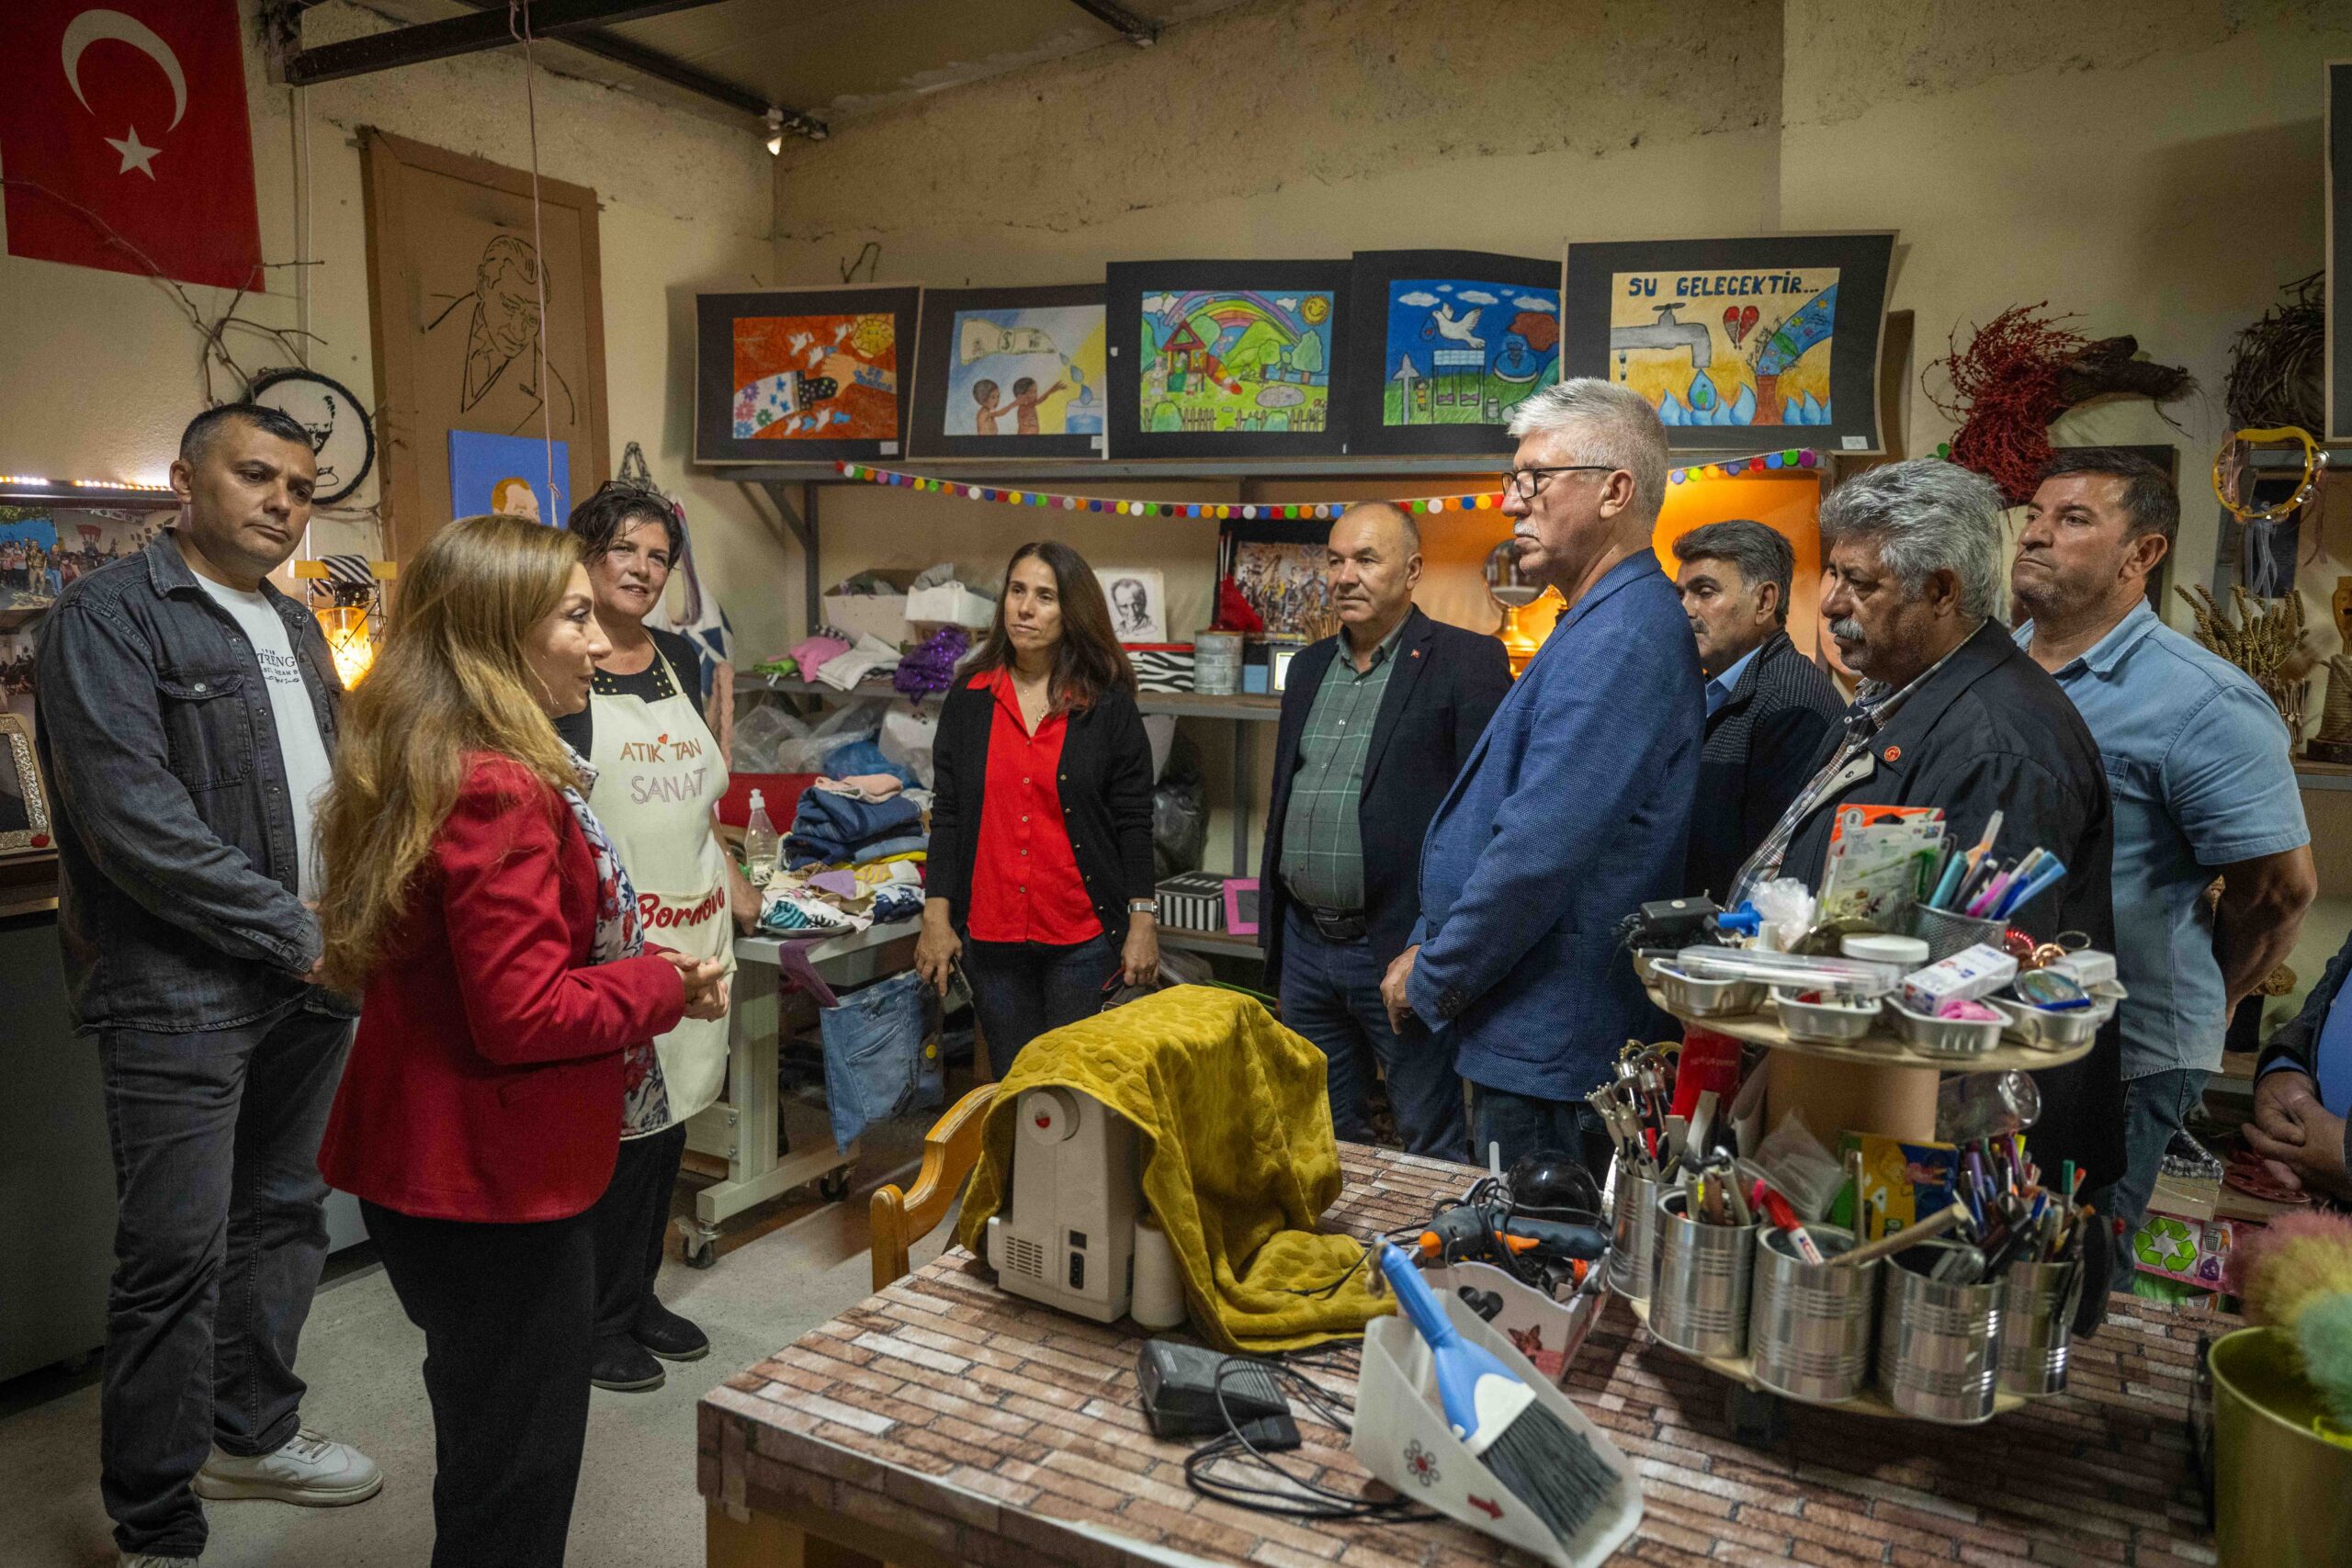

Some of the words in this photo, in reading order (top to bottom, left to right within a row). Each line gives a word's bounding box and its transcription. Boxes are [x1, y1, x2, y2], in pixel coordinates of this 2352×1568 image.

[1628, 277, 1657, 297] SU
[1676, 271, 1819, 297] GELECEKTİR...
[620, 742, 665, 762] ATIK
[670, 738, 702, 761] TAN
[631, 767, 707, 805] SANAT
[637, 886, 726, 930] Bornova
